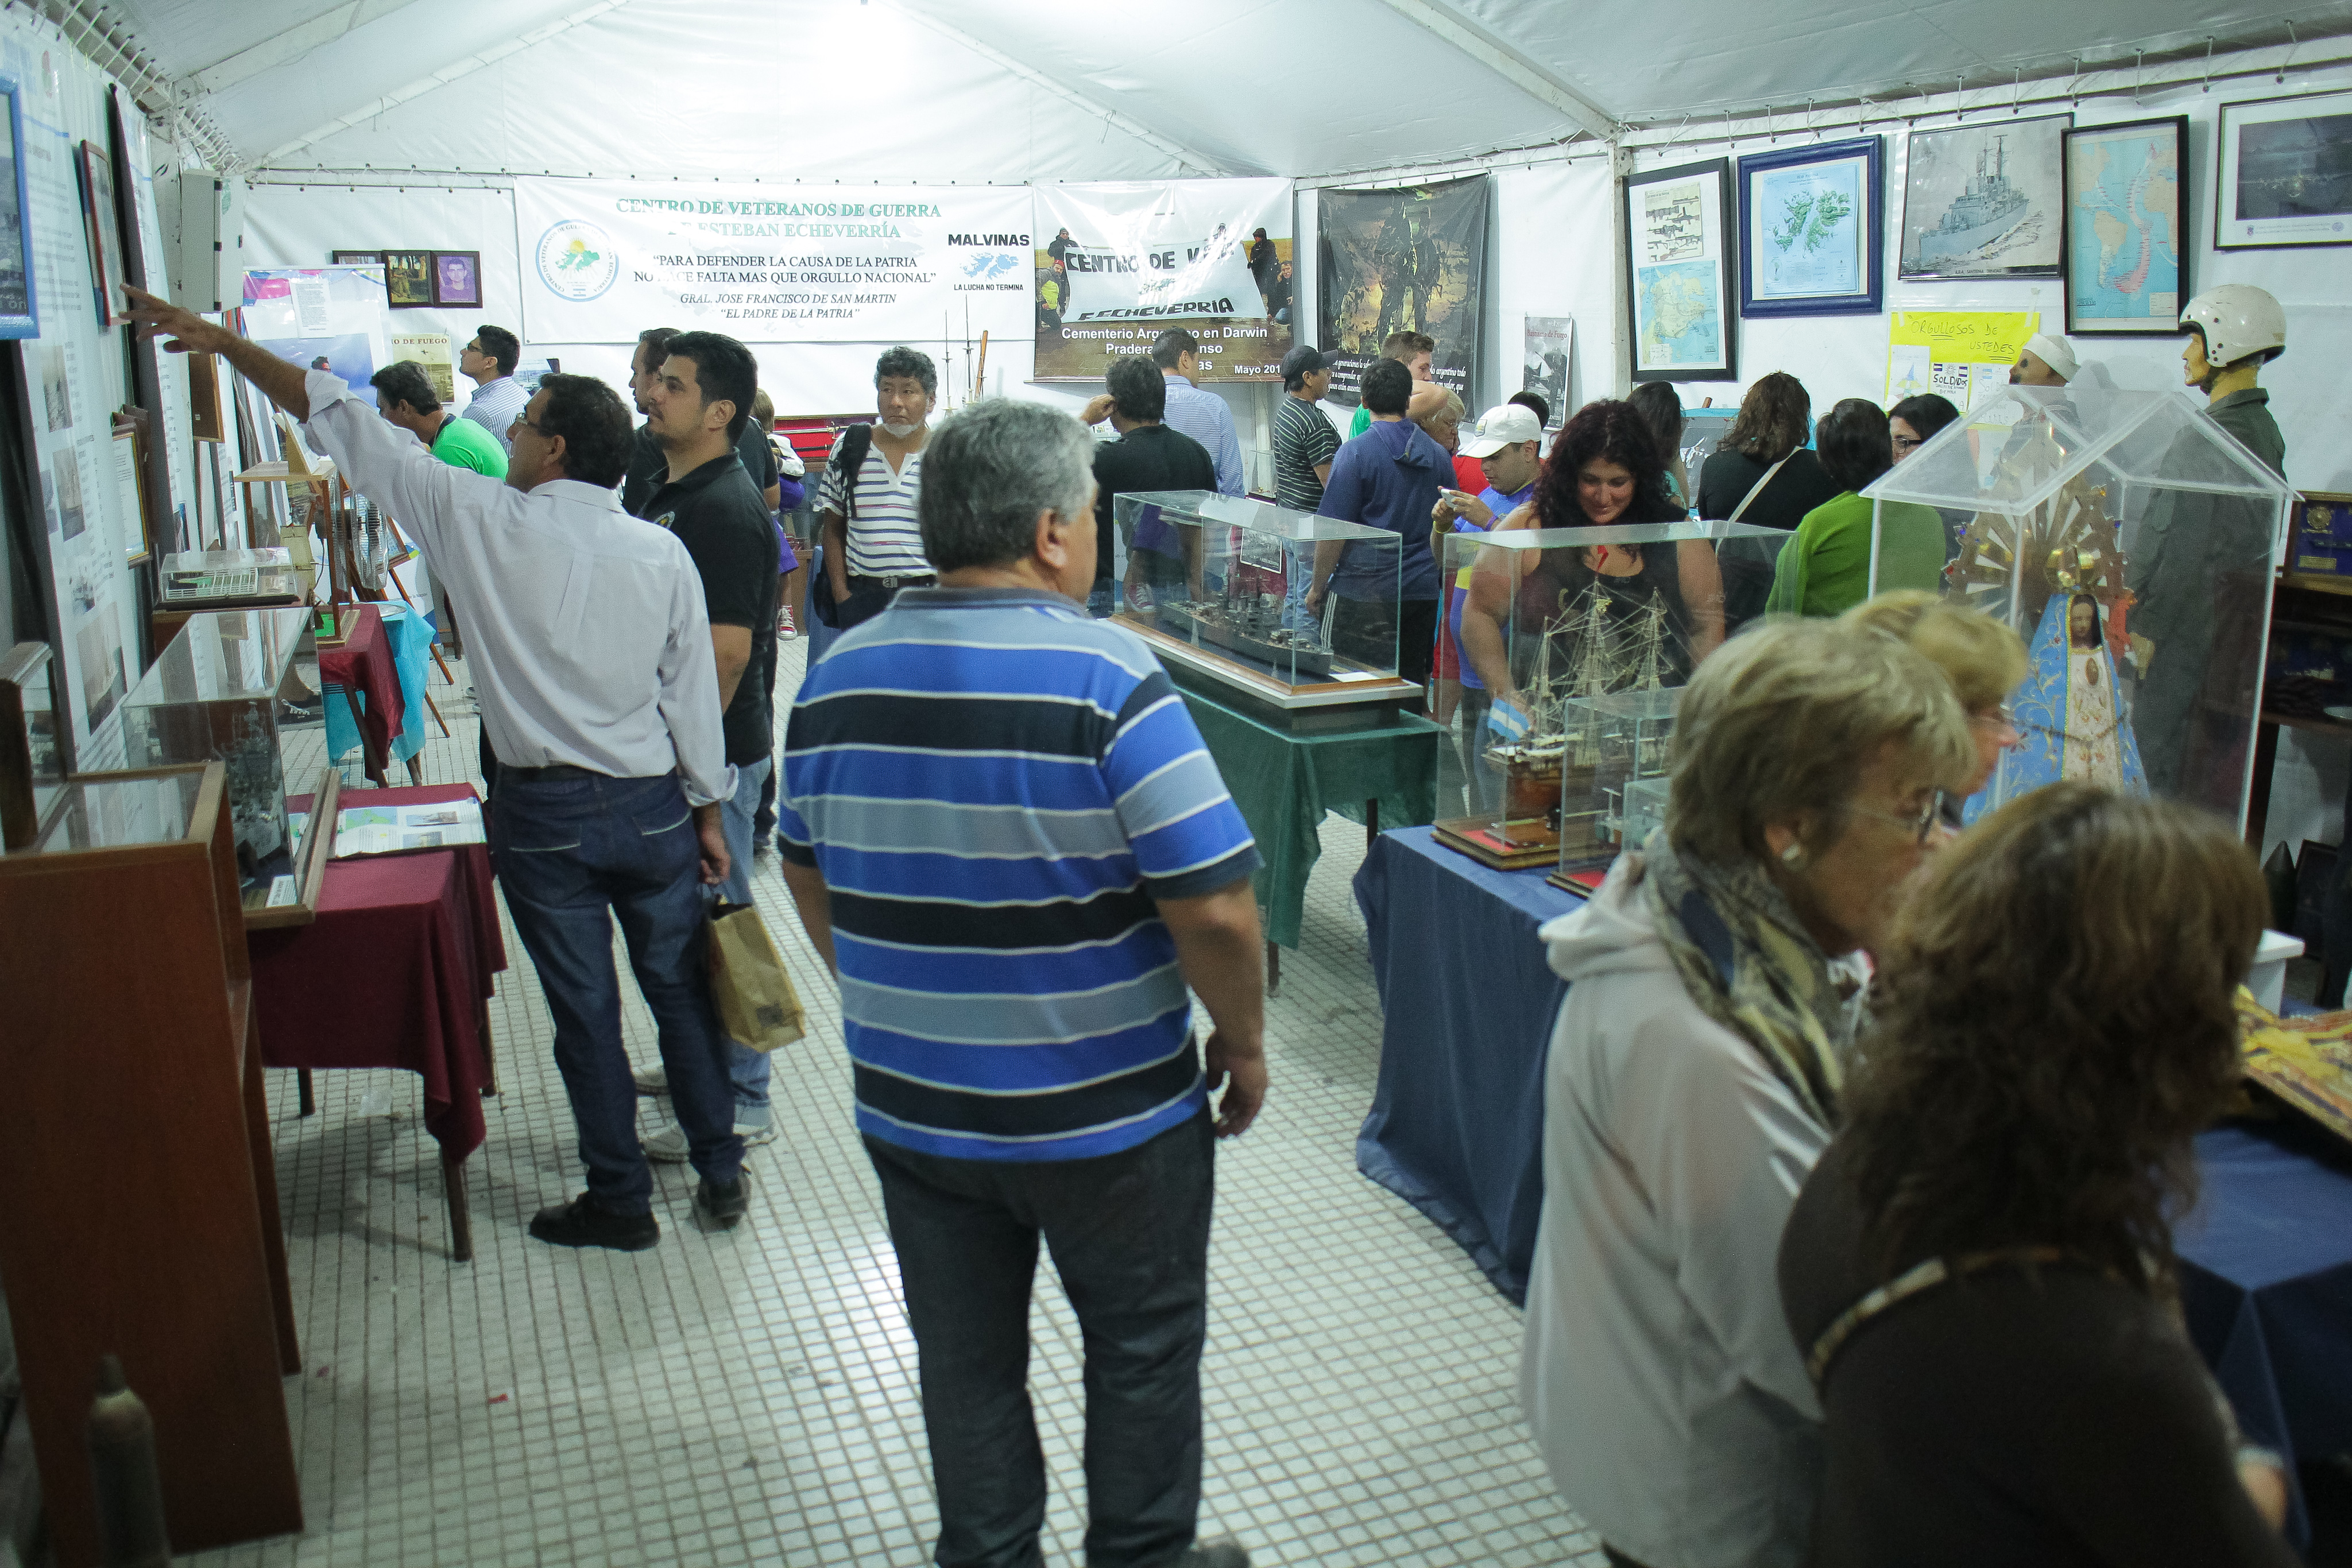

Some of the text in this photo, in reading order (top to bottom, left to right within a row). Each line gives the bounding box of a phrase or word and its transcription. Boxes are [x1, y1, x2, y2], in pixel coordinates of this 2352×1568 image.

[616, 198, 942, 218] CENTRO DE VETERANOS DE GUERRA
[698, 222, 779, 237] ESTEBAN
[784, 220, 901, 238] ECHEVERRÍA
[948, 234, 1030, 246] MALVINAS
[653, 255, 918, 268] “PARA DEFENDER LA CAUSA DE LA PATRIA
[1065, 253, 1140, 273] CENTRO
[1150, 251, 1175, 270] DE
[633, 271, 937, 285] NO ACE FALTA MAS QUE ORGULLO NACIONAL”
[680, 293, 896, 304] GRAL. JOSE FRANCISCO DE SAN MARTIN
[721, 309, 740, 319] “EL
[742, 309, 779, 318] PADRE
[782, 309, 797, 318] DE
[799, 309, 813, 318] LA
[1061, 327, 1134, 339] Cementerio
[1203, 330, 1219, 338] en
[1223, 326, 1268, 338] Darwin
[1548, 330, 1553, 338] de
[1554, 330, 1567, 340] Fuego
[1985, 324, 1998, 335] DE
[1106, 343, 1153, 355] Pradera
[1234, 365, 1281, 376] Mayo 201
[1436, 367, 1457, 379] argentino
[1457, 366, 1466, 377] todo
[1456, 384, 1464, 394] que
